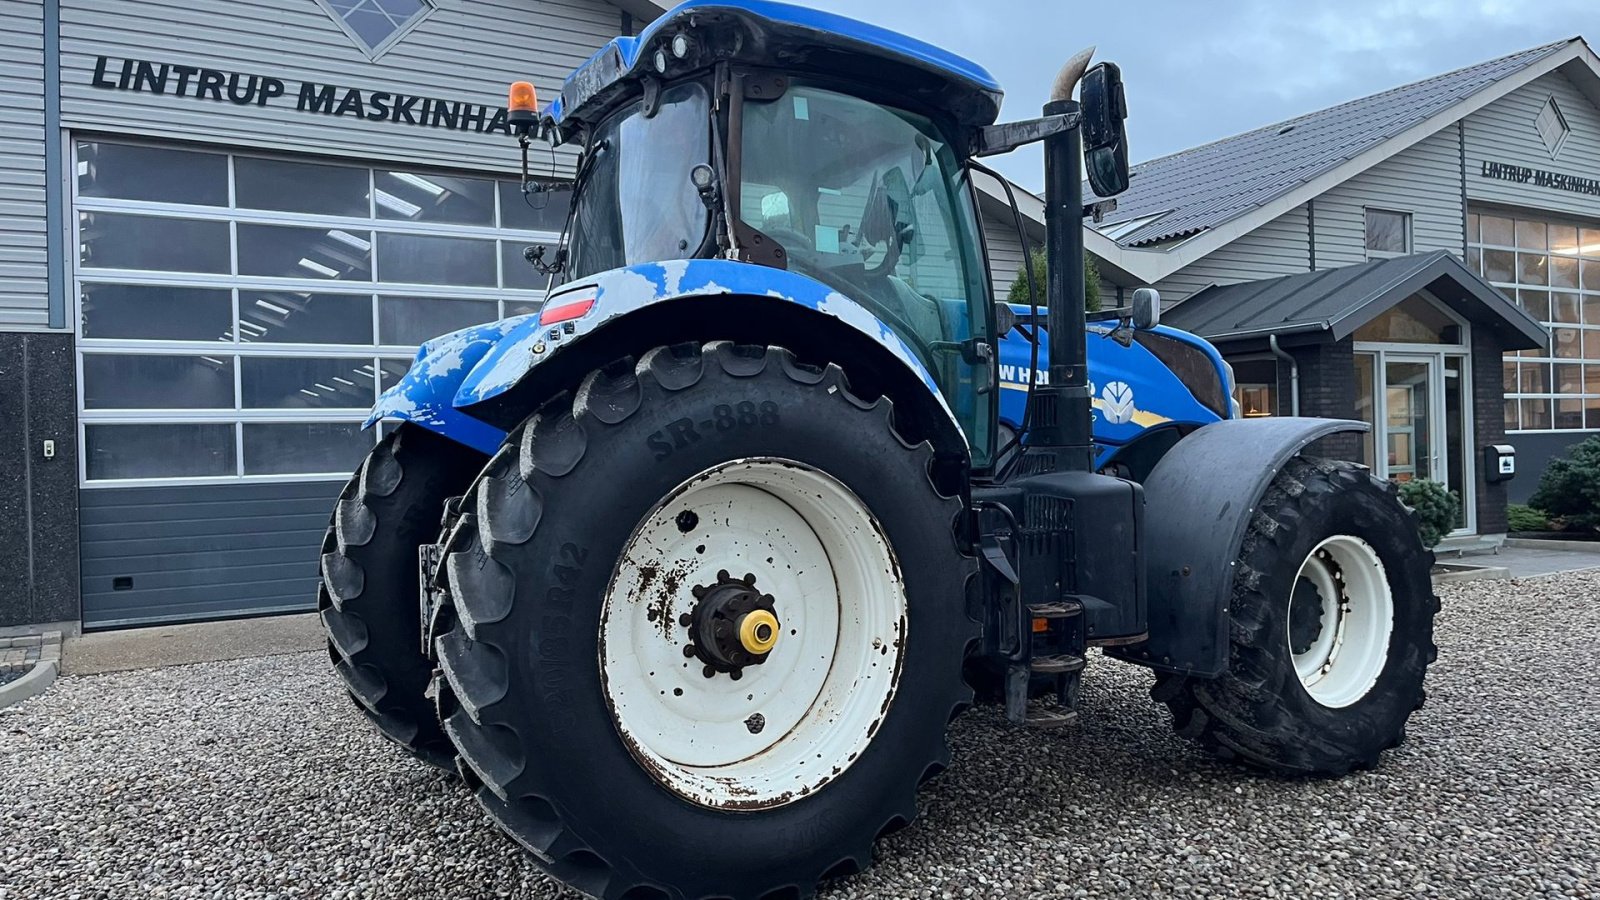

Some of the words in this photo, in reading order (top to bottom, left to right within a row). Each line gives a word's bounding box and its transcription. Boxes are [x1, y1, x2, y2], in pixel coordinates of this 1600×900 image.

[92, 56, 284, 106] LINTRUP
[1481, 160, 1532, 184] LINTRUP
[647, 400, 779, 463] SR-888
